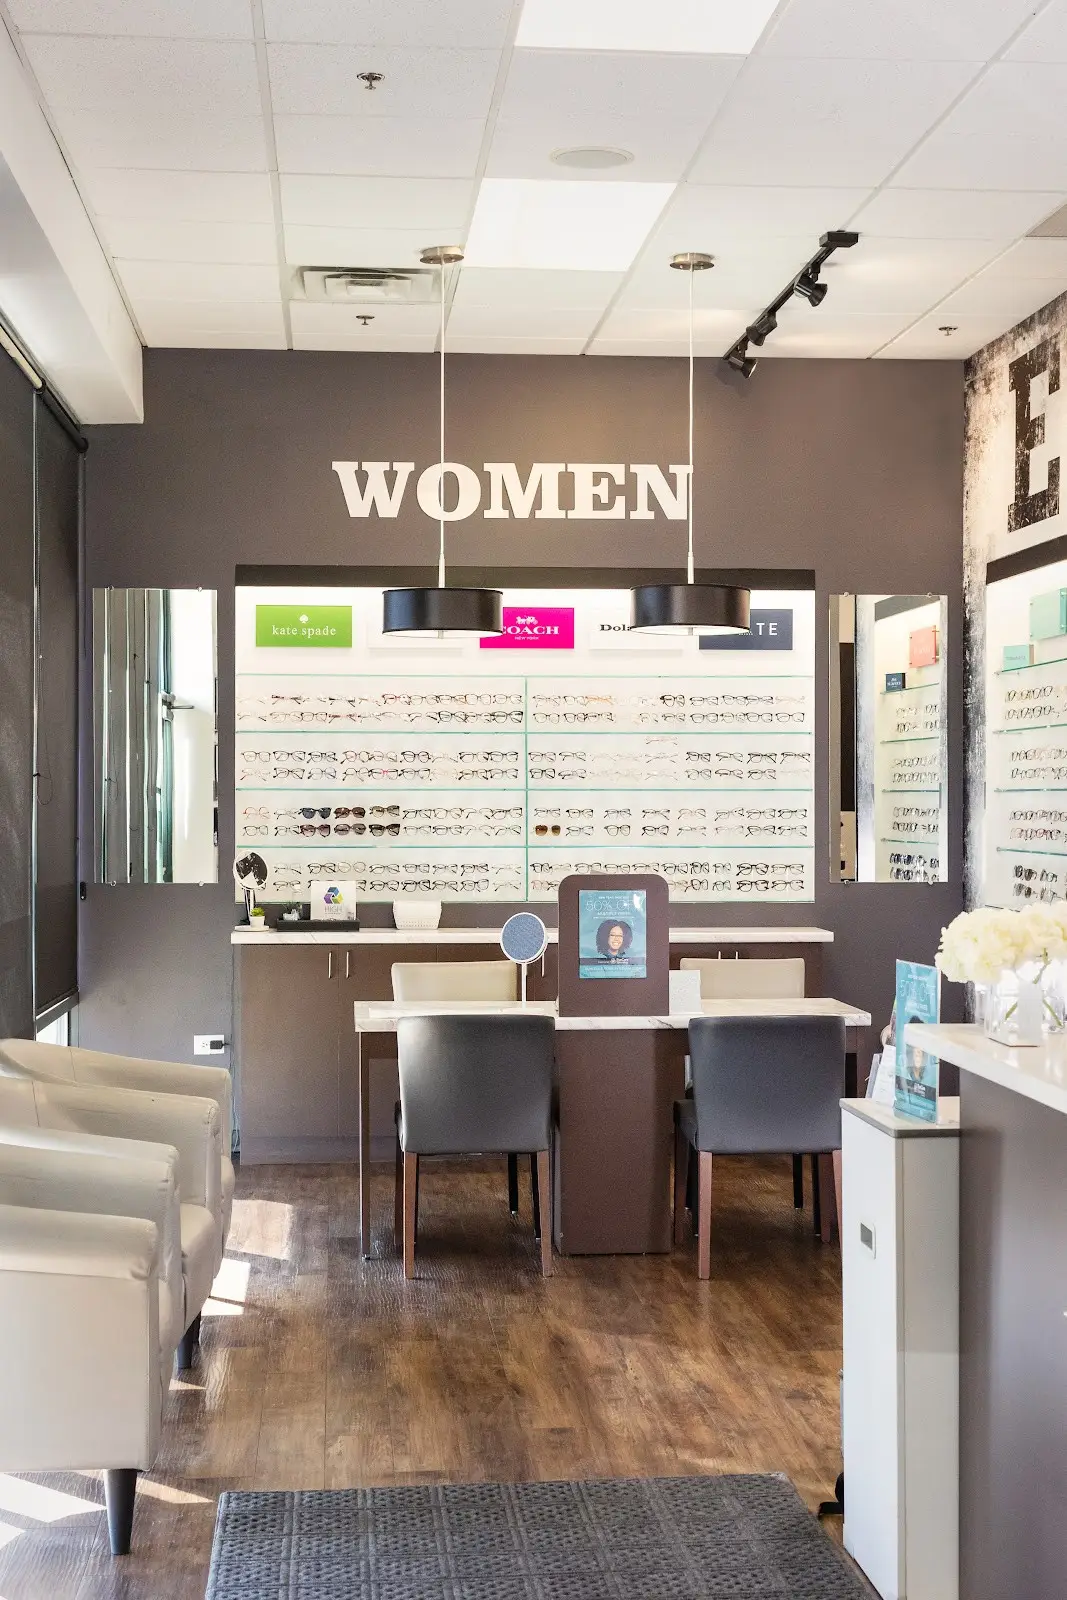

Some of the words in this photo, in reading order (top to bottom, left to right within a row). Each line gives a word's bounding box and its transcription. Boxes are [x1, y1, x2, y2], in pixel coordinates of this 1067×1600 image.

[332, 461, 694, 521] WOMEN
[272, 625, 298, 636] kate
[301, 626, 337, 639] spade
